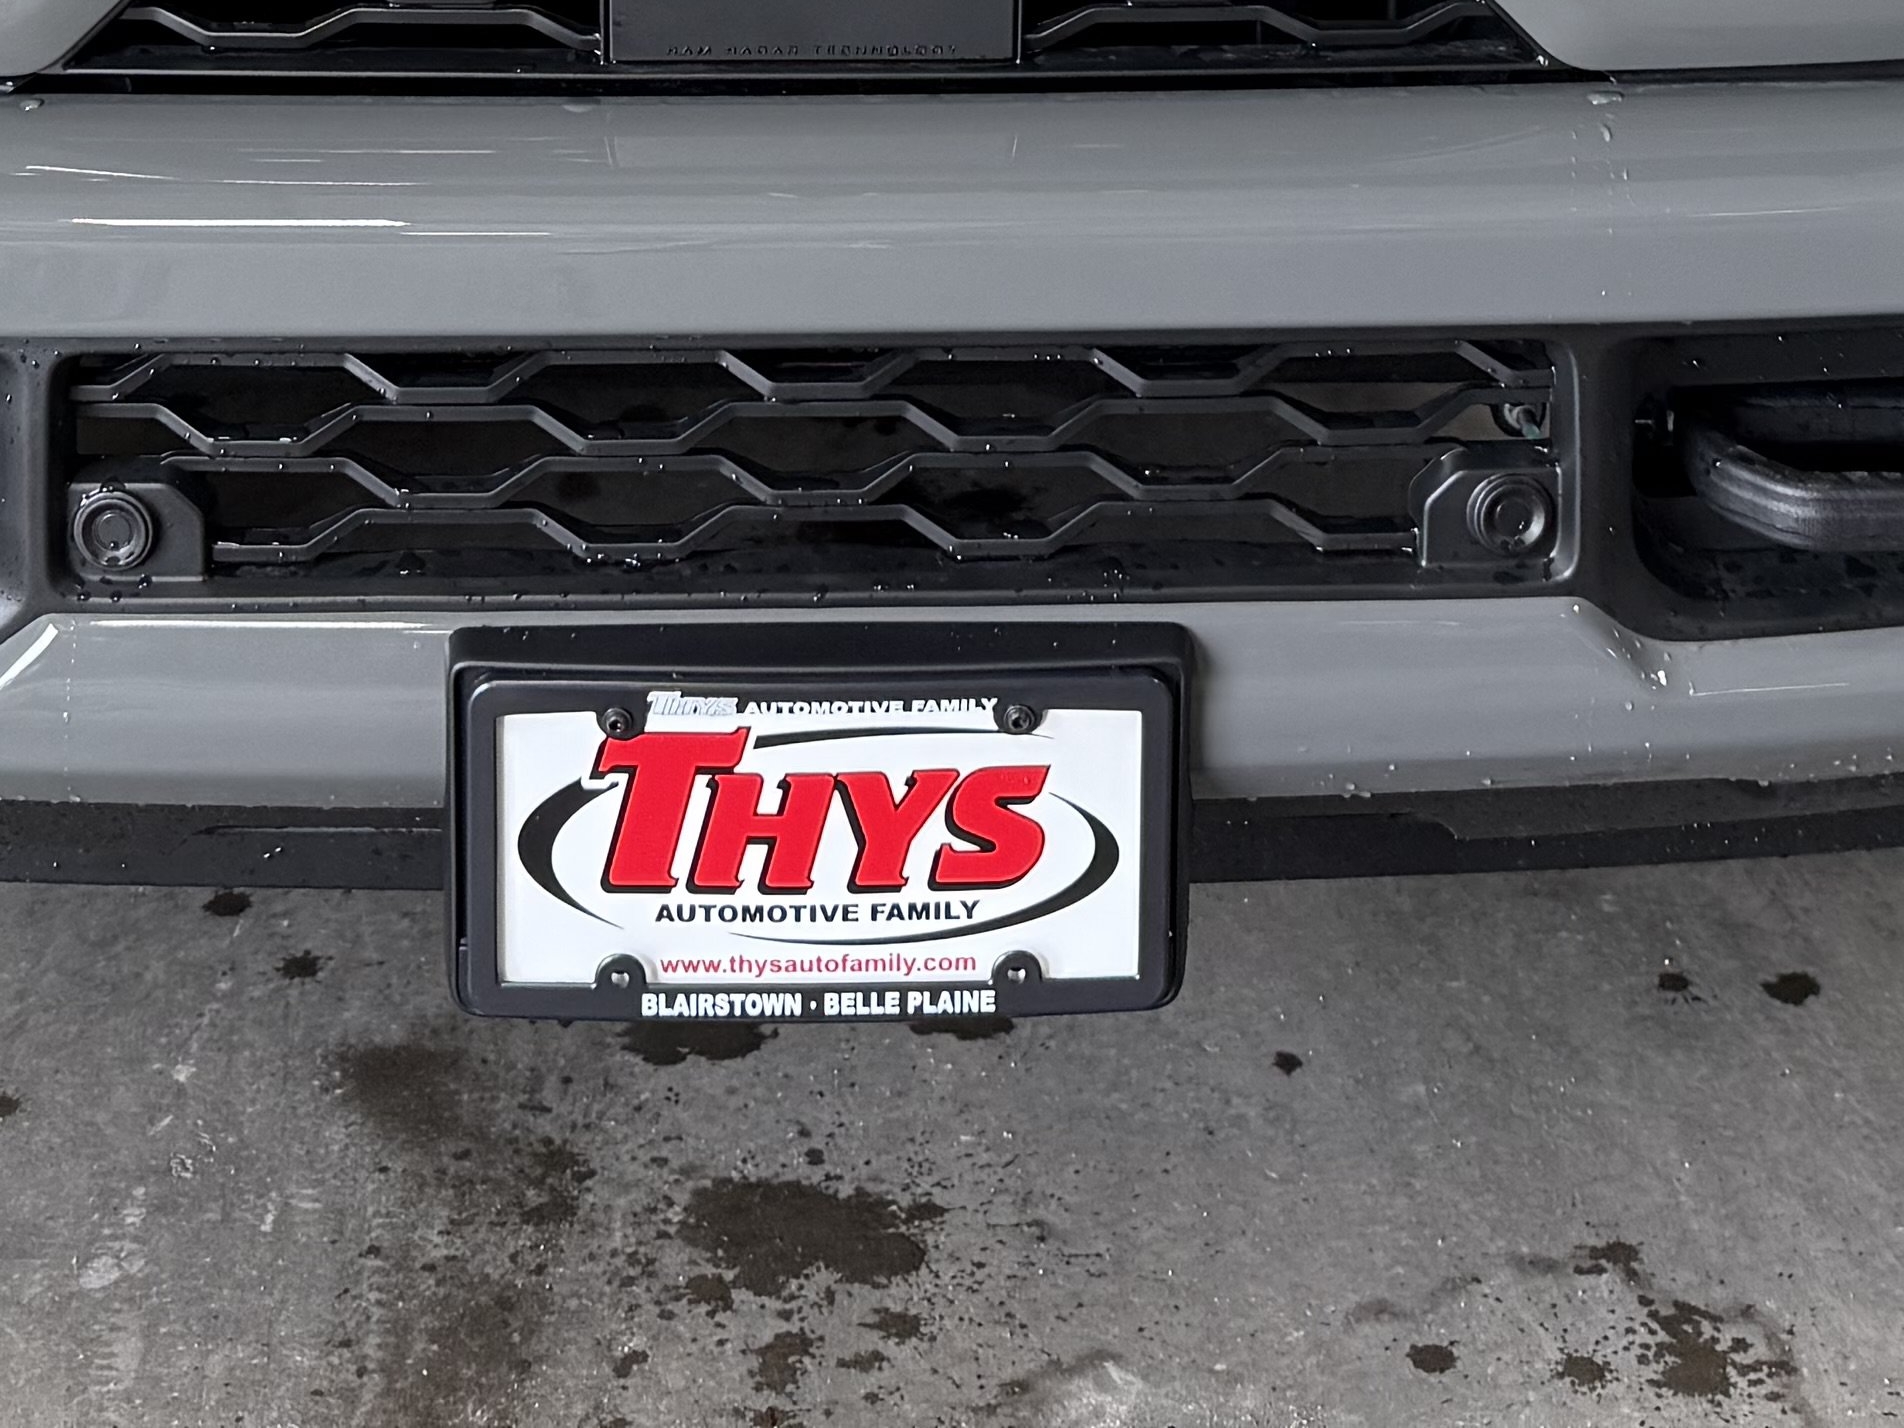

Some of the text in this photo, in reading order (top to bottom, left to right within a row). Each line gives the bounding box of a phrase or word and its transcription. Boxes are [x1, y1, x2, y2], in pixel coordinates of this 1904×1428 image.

[746, 700, 905, 715] AUTOMOTIVE
[911, 697, 998, 715] FAMILY
[596, 726, 1052, 894] THYS
[655, 899, 981, 923] AUTOMOTIVE FAMILY
[660, 952, 977, 978] www.thysautofamily.com
[641, 989, 997, 1017] BLAIRSTOWN BELLE PLAINE
